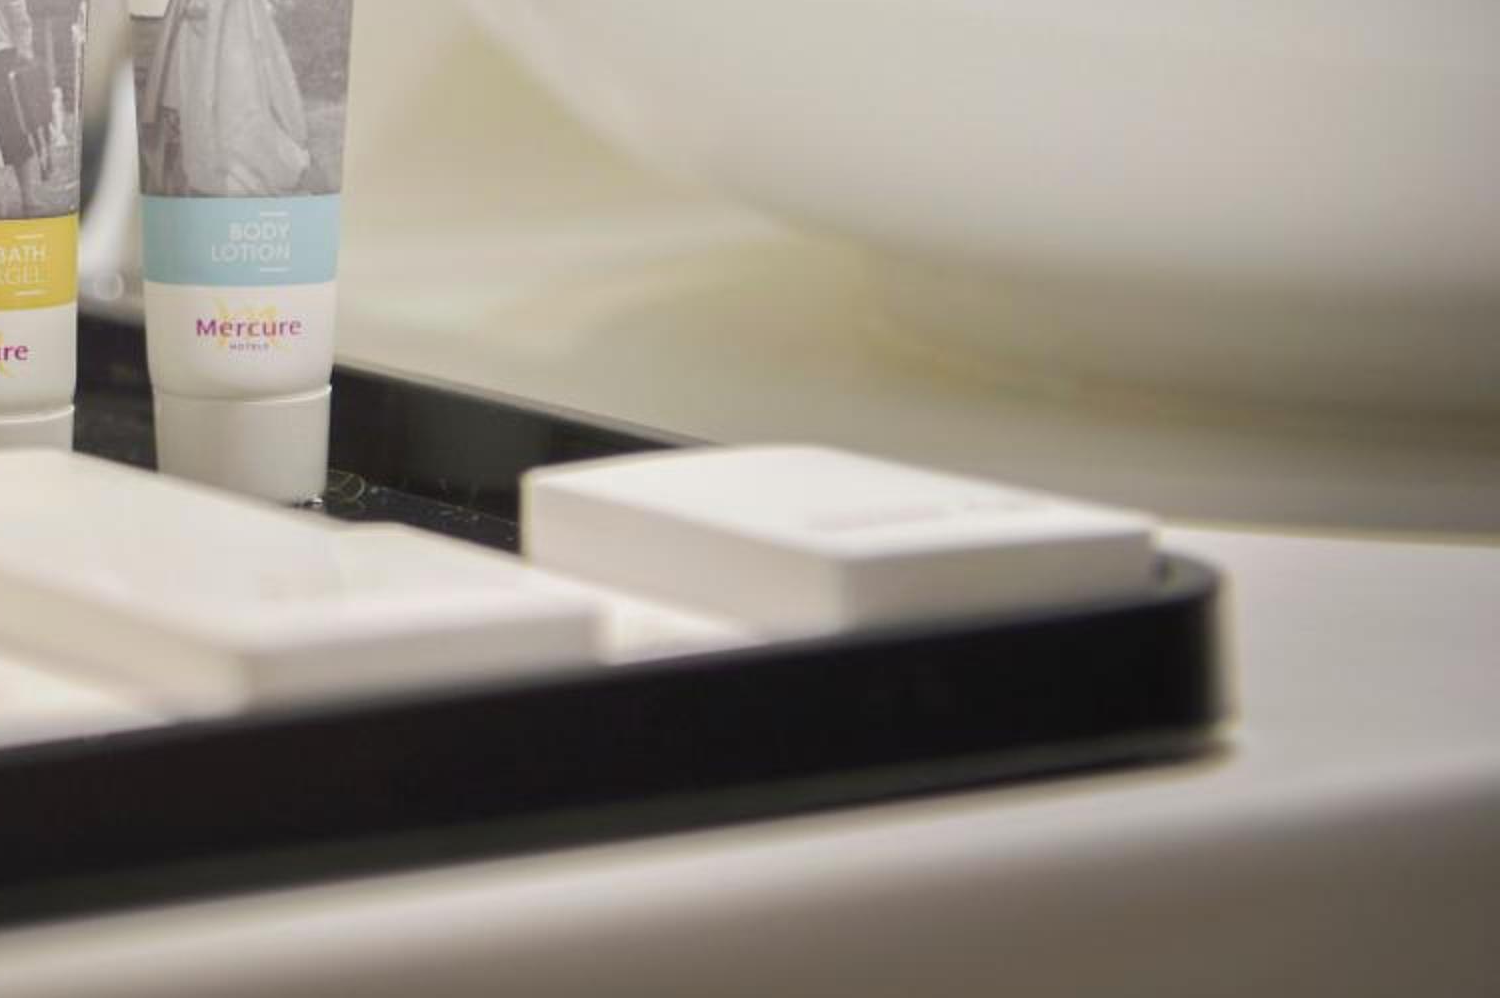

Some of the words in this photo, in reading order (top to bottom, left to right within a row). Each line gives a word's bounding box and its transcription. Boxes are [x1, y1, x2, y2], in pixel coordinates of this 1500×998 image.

[228, 221, 291, 242] BODY
[211, 242, 291, 262] LOTION
[195, 318, 303, 338] Mercure
